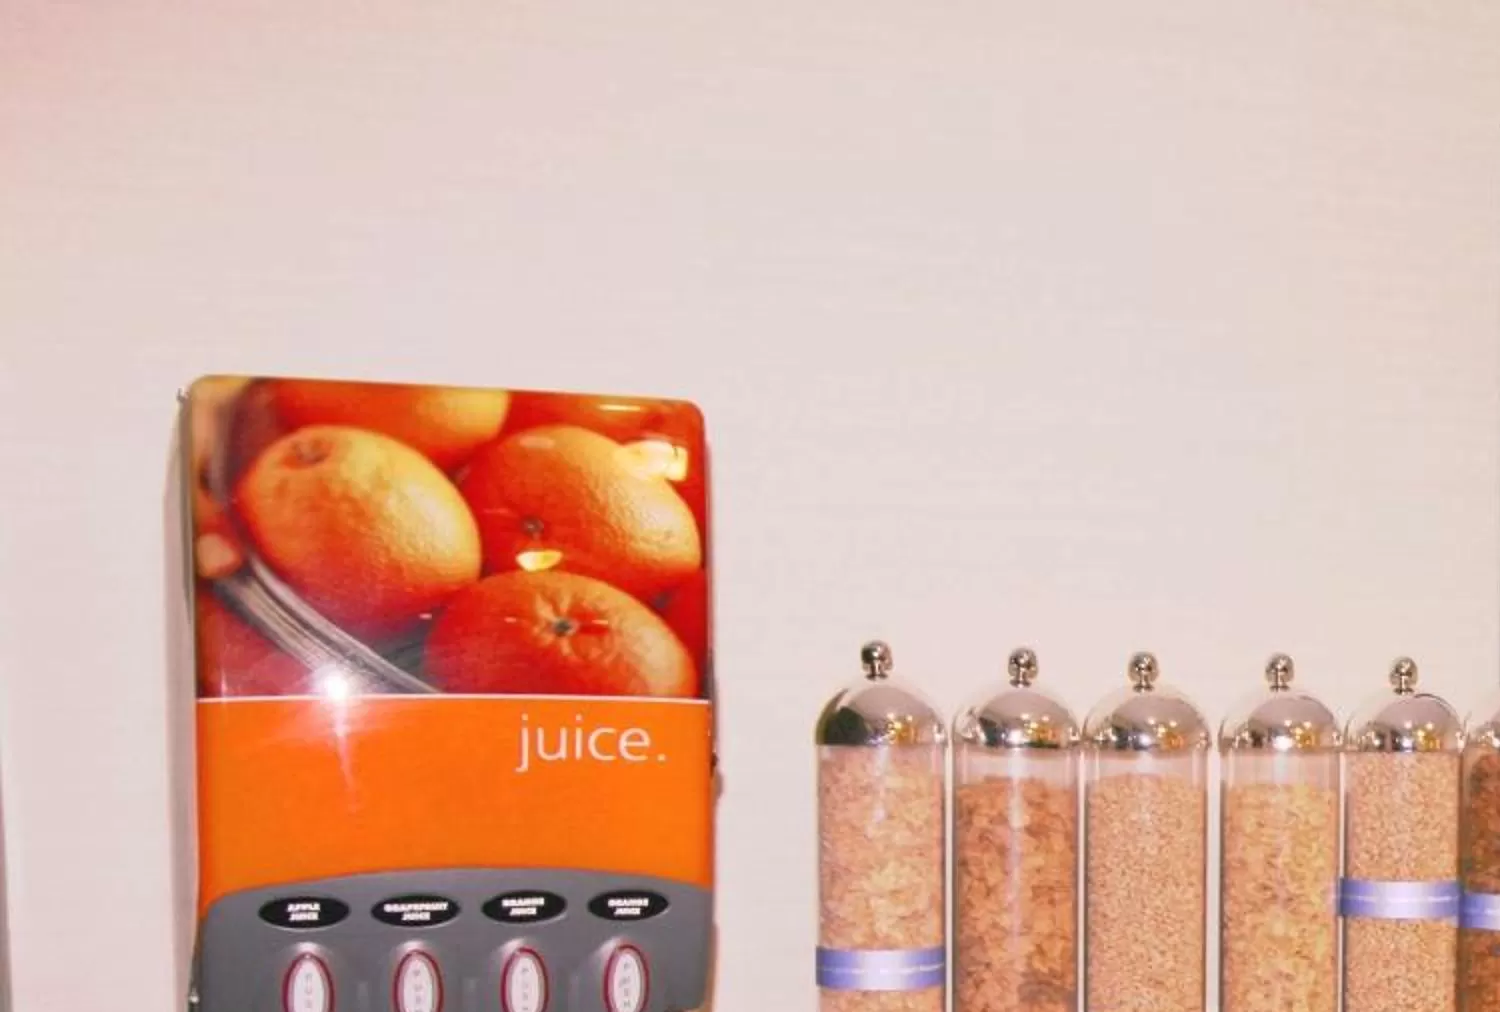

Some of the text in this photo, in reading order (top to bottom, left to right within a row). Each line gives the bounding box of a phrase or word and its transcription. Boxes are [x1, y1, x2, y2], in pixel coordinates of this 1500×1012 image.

[514, 713, 667, 773] juice.
[287, 902, 321, 912] APPLE
[502, 897, 545, 907] ORANGE
[607, 897, 649, 907] ORANGE
[289, 911, 320, 921] JUICE
[401, 911, 431, 921] JUICE
[509, 907, 537, 916] JUICE
[614, 907, 641, 916] JUICE
